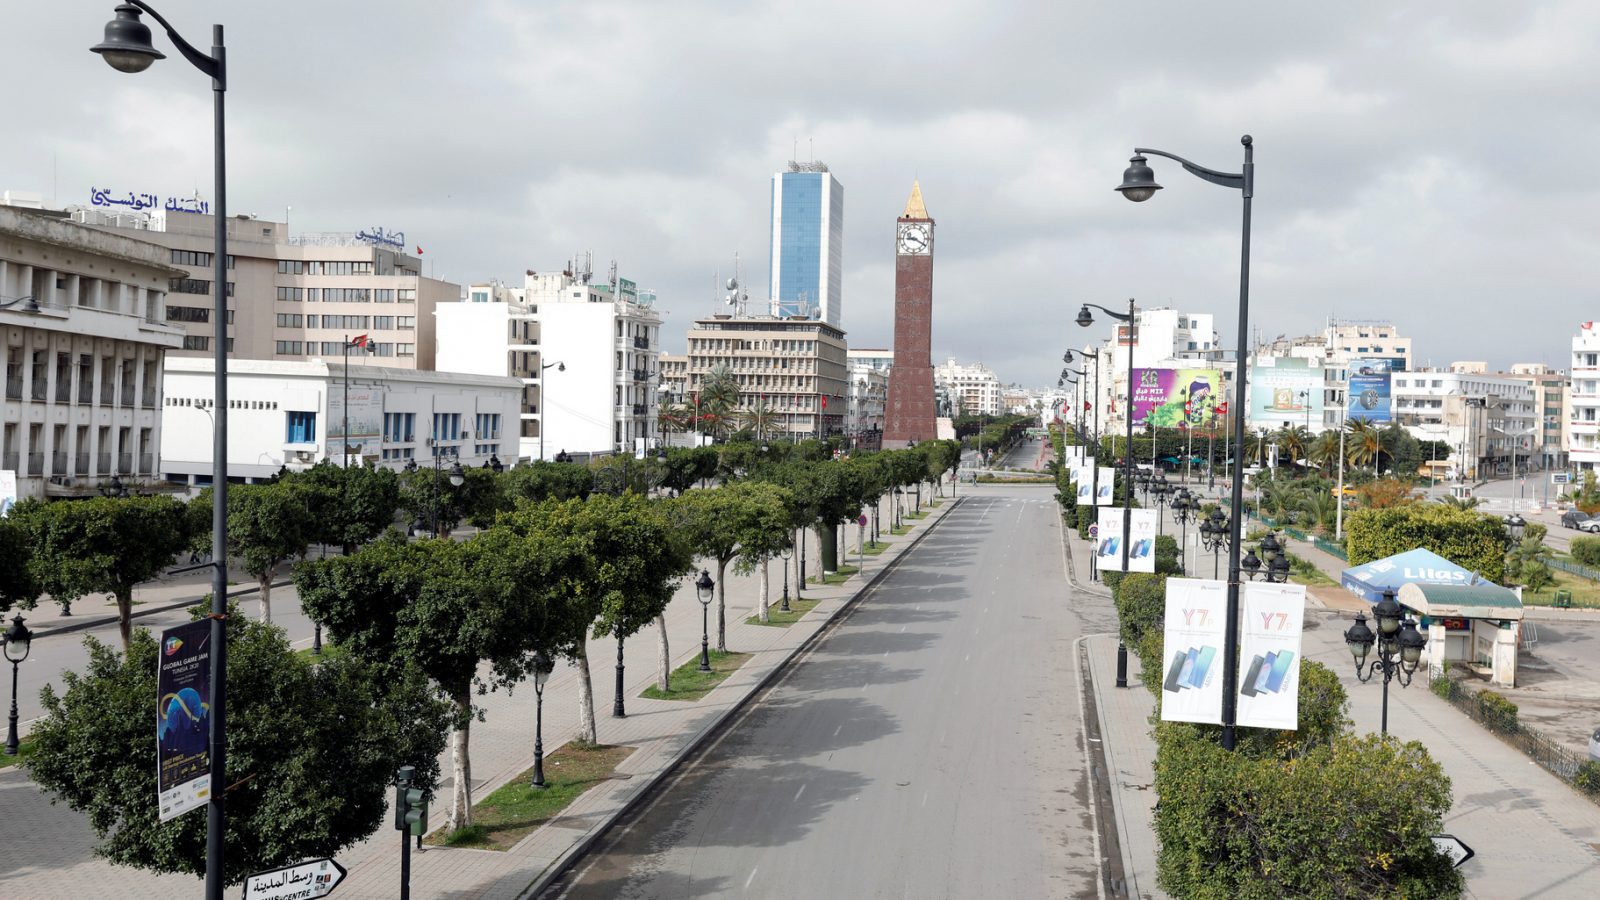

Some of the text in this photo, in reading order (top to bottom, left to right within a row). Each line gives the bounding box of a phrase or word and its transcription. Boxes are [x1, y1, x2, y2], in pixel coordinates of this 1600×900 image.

[1404, 567, 1466, 580] Lilas
[162, 660, 183, 671] GLOBAL
[183, 656, 197, 664] GAME
[253, 869, 313, 894] وسط المدينة
